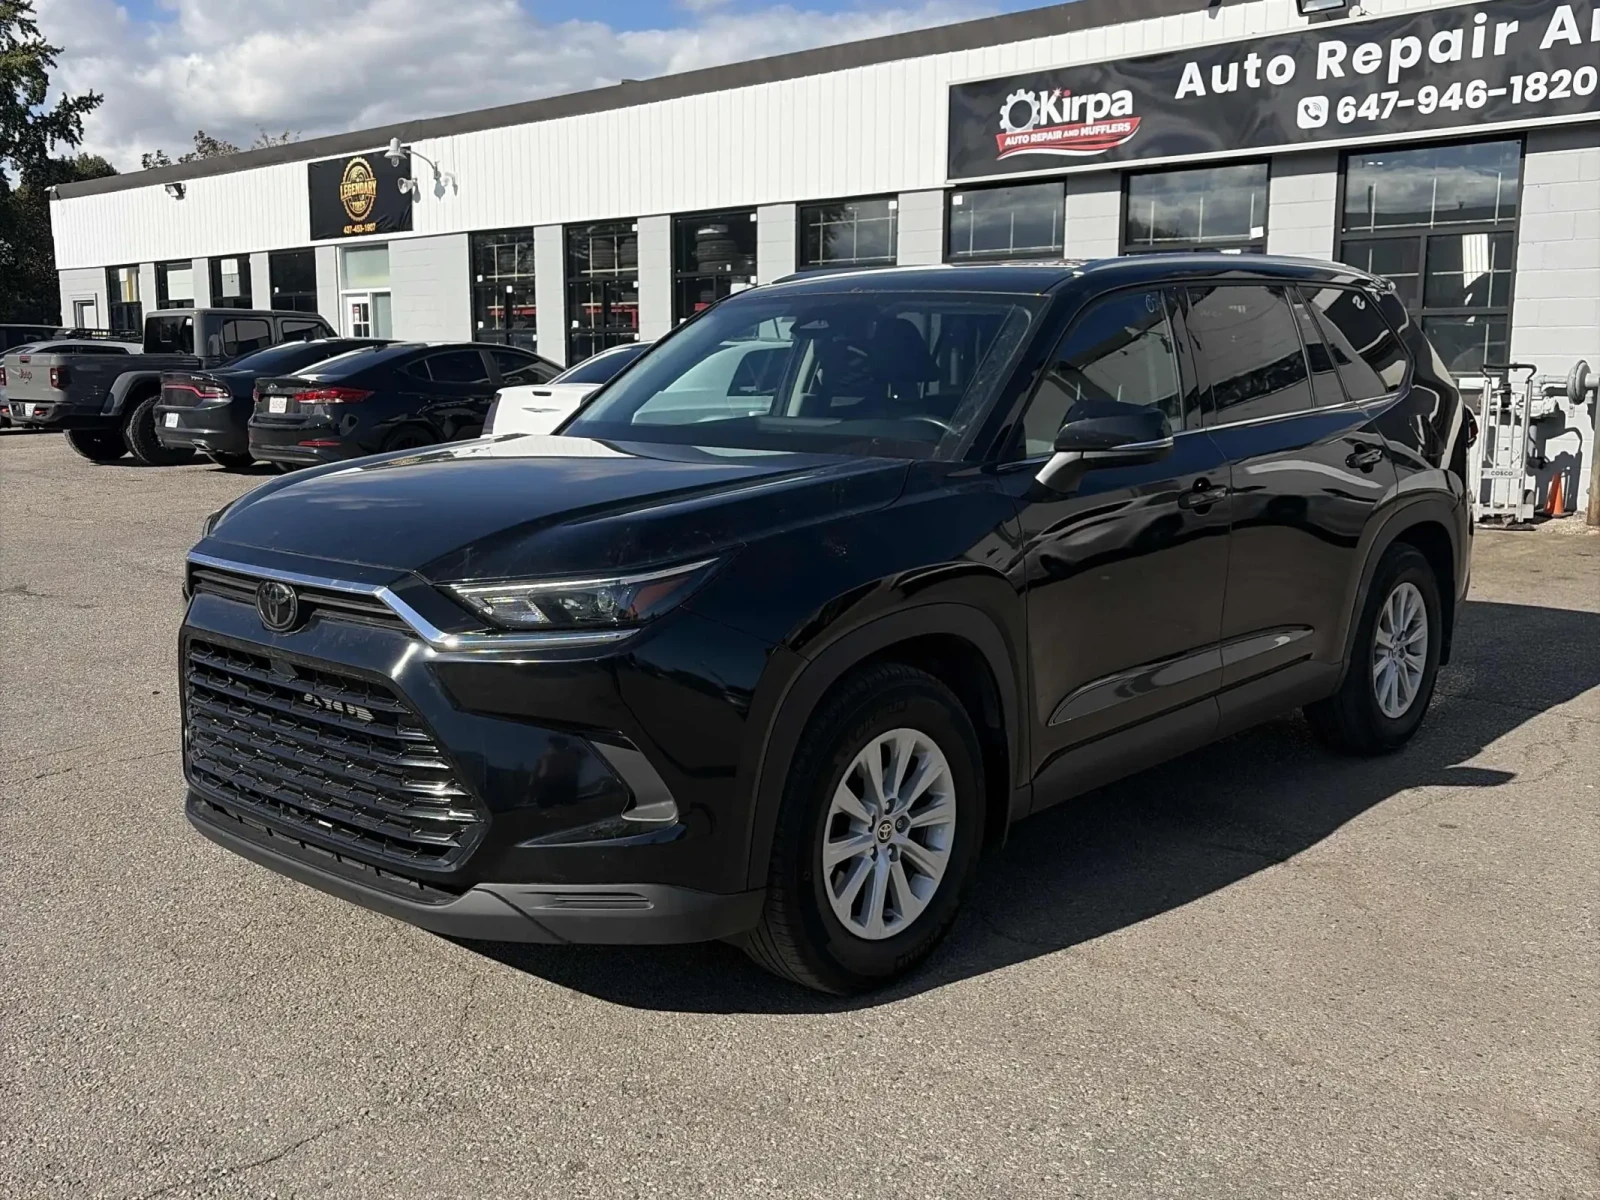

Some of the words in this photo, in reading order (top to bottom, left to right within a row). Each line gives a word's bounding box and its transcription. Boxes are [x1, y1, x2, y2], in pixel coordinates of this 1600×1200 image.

[1175, 52, 1296, 100] Auto
[1316, 12, 1519, 84] Repair
[1039, 87, 1133, 126] Kirpa
[1336, 65, 1598, 124] 647-946-1820
[1004, 135, 1030, 146] AUTO
[1030, 131, 1062, 143] REPAIR
[1063, 129, 1079, 138] AND
[1080, 122, 1131, 137] MUFFLERS
[340, 180, 377, 198] LEGENDARY
